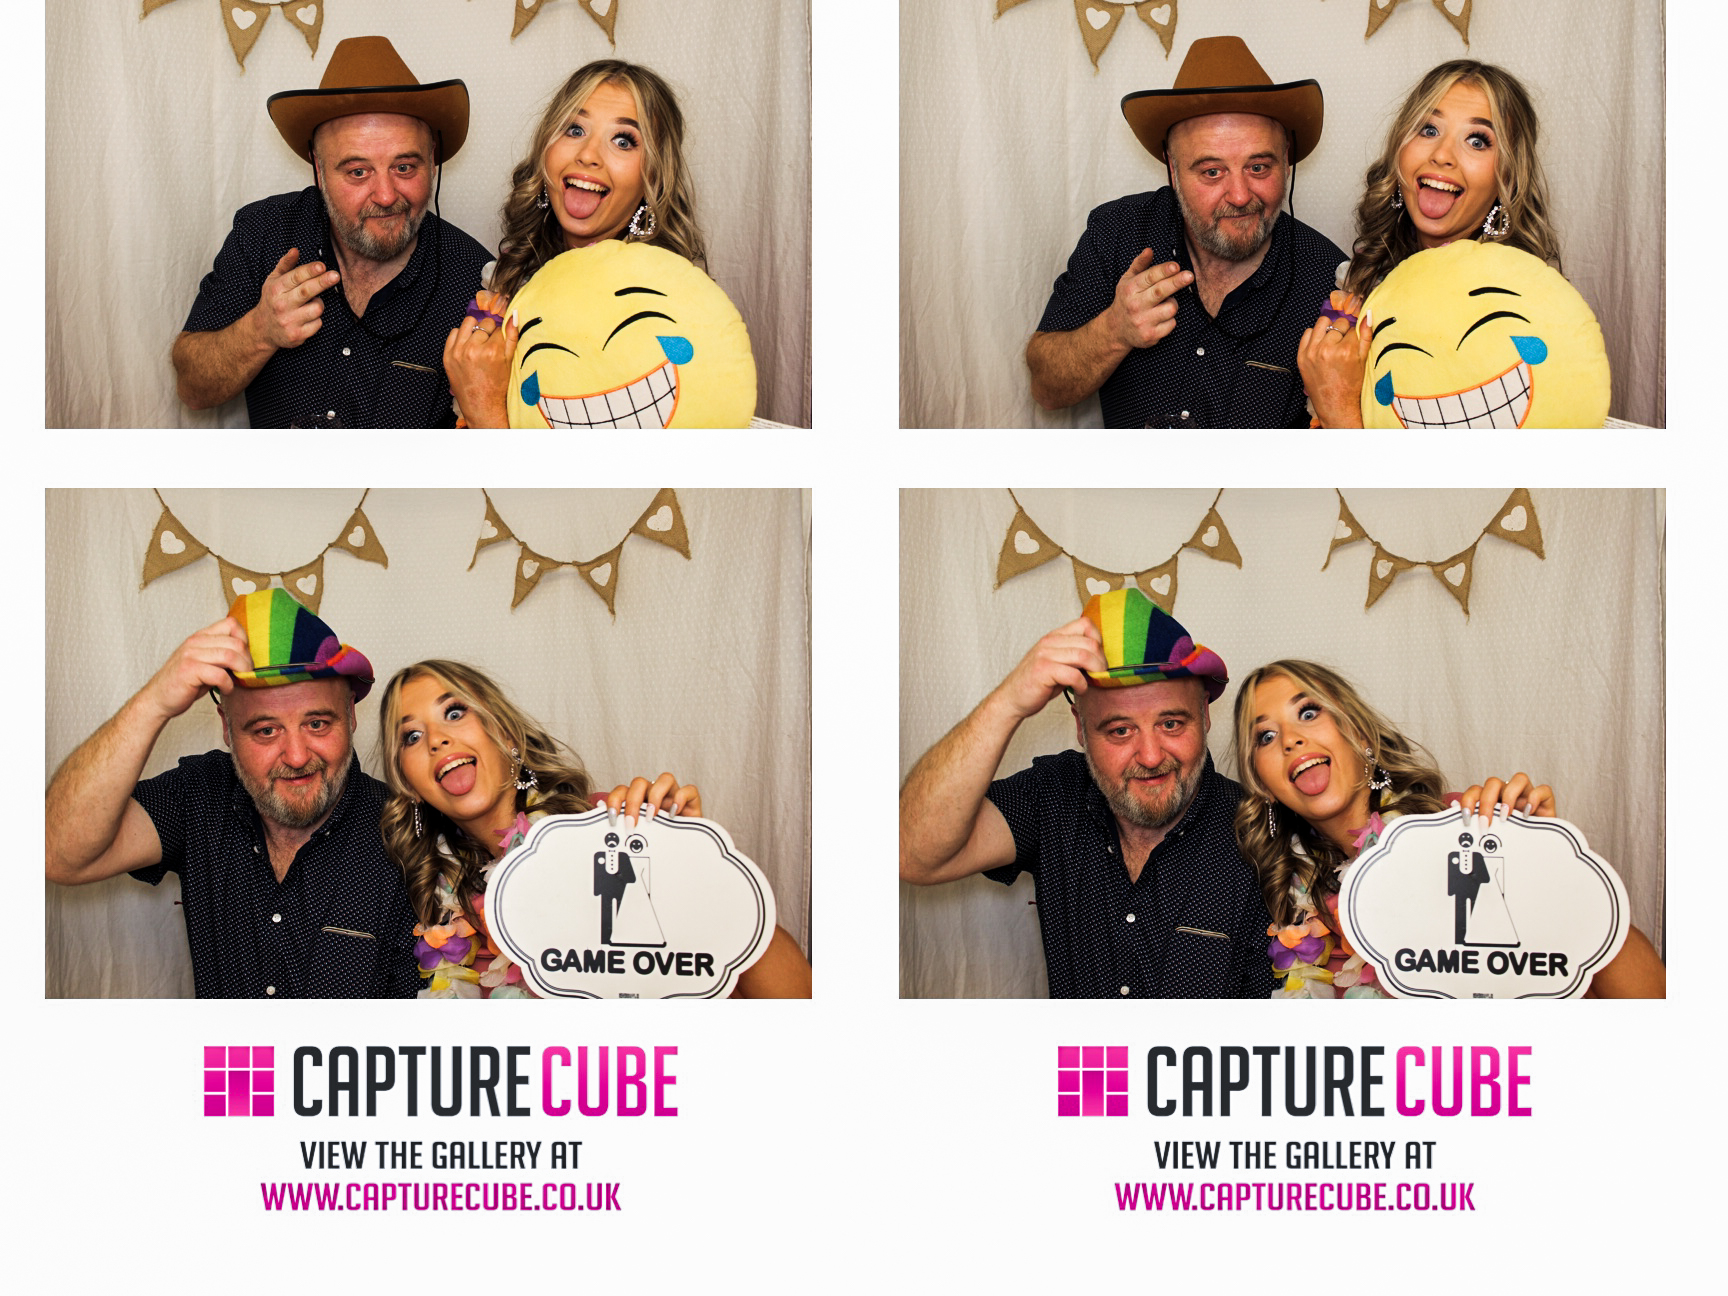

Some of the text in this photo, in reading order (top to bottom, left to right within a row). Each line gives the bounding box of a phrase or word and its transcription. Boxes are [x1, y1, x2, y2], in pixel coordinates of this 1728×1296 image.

[540, 948, 715, 977] GAME OVER
[1394, 948, 1569, 977] GAME OVER
